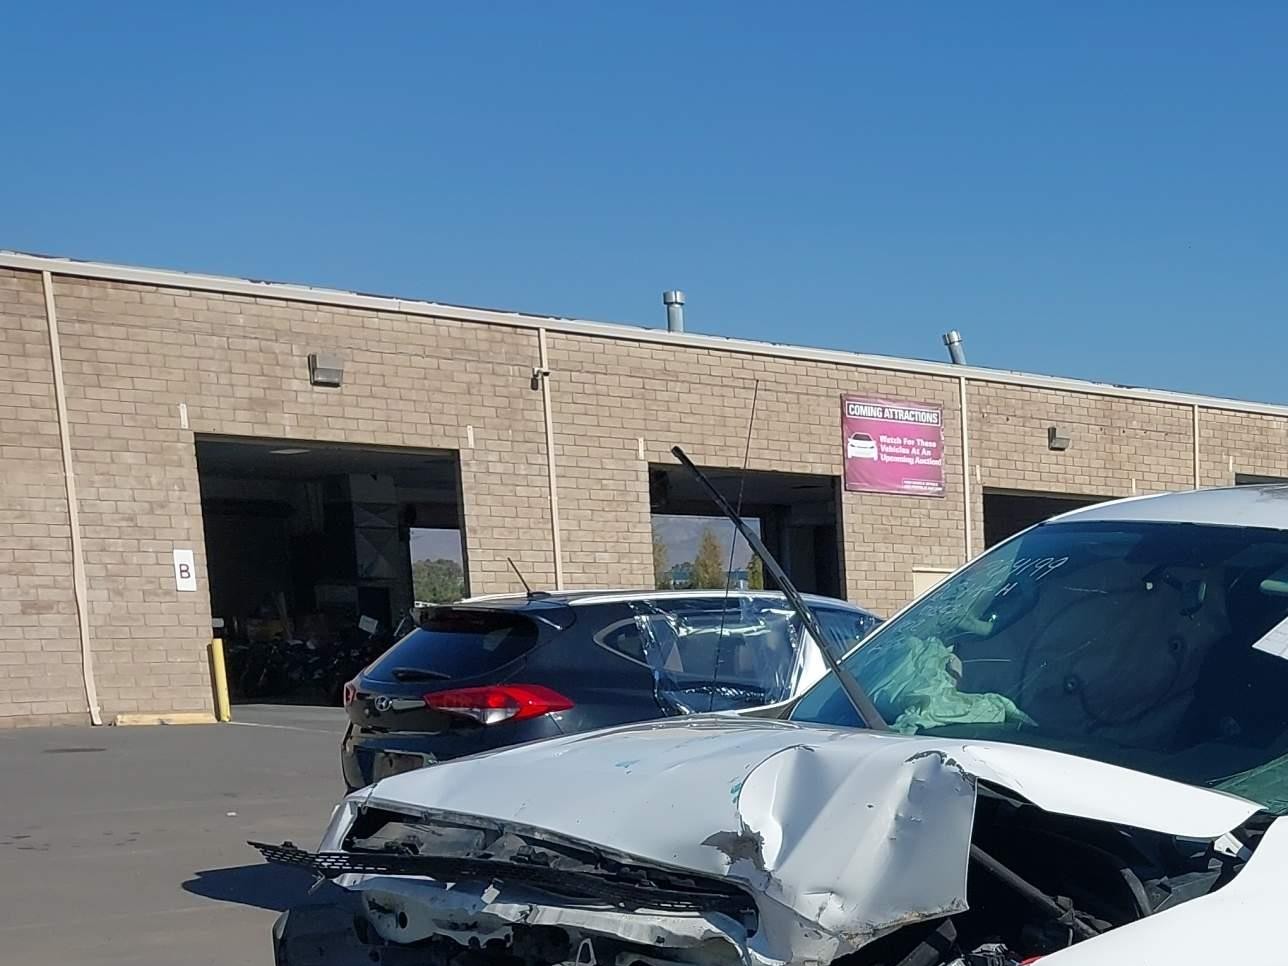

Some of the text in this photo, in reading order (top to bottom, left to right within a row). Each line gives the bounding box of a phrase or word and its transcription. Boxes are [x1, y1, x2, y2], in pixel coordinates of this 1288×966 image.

[848, 404, 938, 423] COMING ATTRACTIONS
[879, 435, 937, 448] Watch For These
[880, 444, 932, 456] Vehicles At An
[880, 453, 914, 465] Upcoming
[179, 563, 191, 579] B
